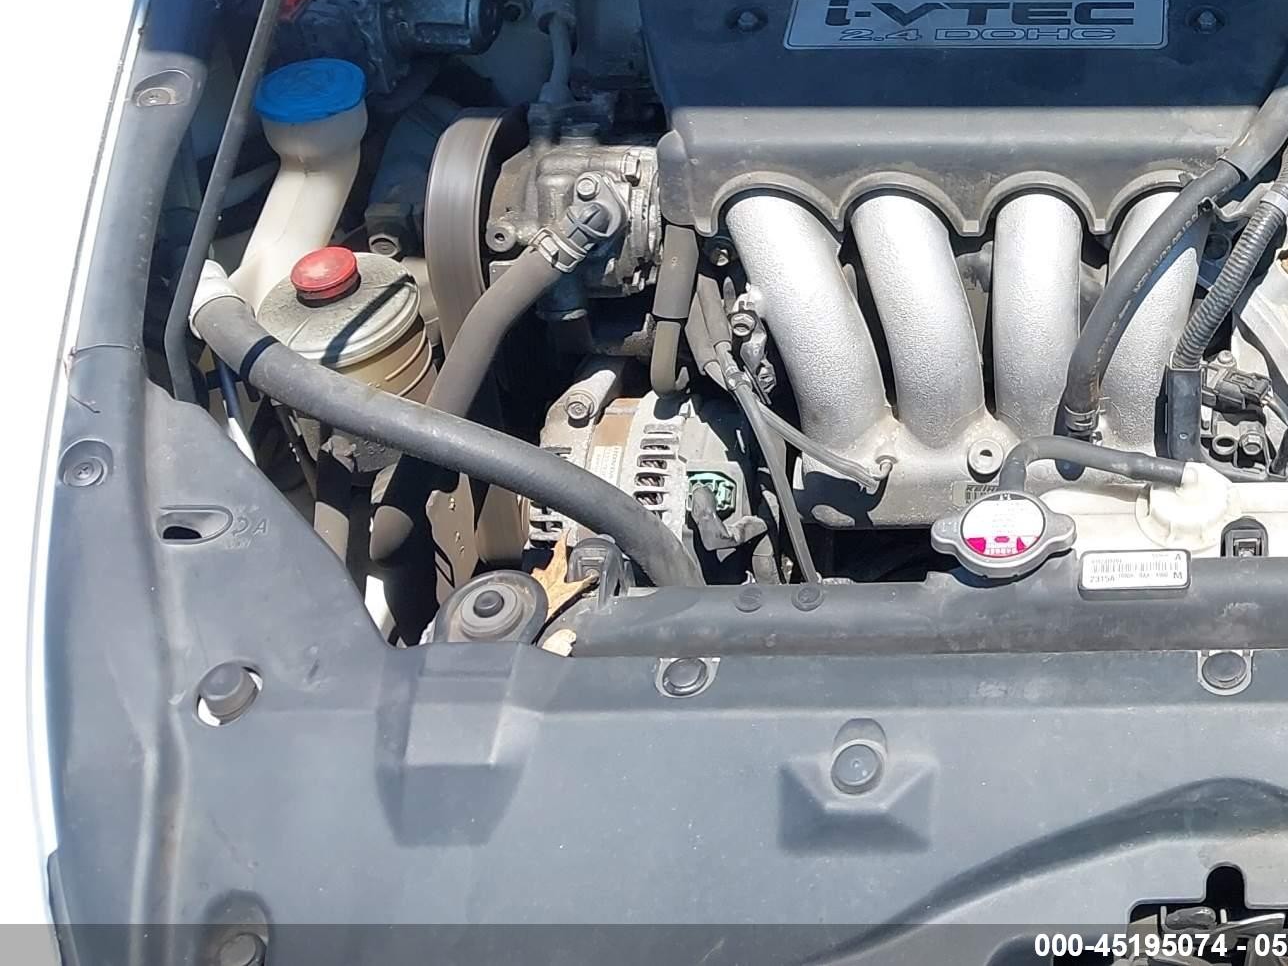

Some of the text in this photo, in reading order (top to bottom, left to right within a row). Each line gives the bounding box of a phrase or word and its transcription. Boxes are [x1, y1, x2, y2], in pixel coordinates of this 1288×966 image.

[825, 0, 1134, 26] i-VTEC
[839, 28, 1117, 42] 2.4 DOHC
